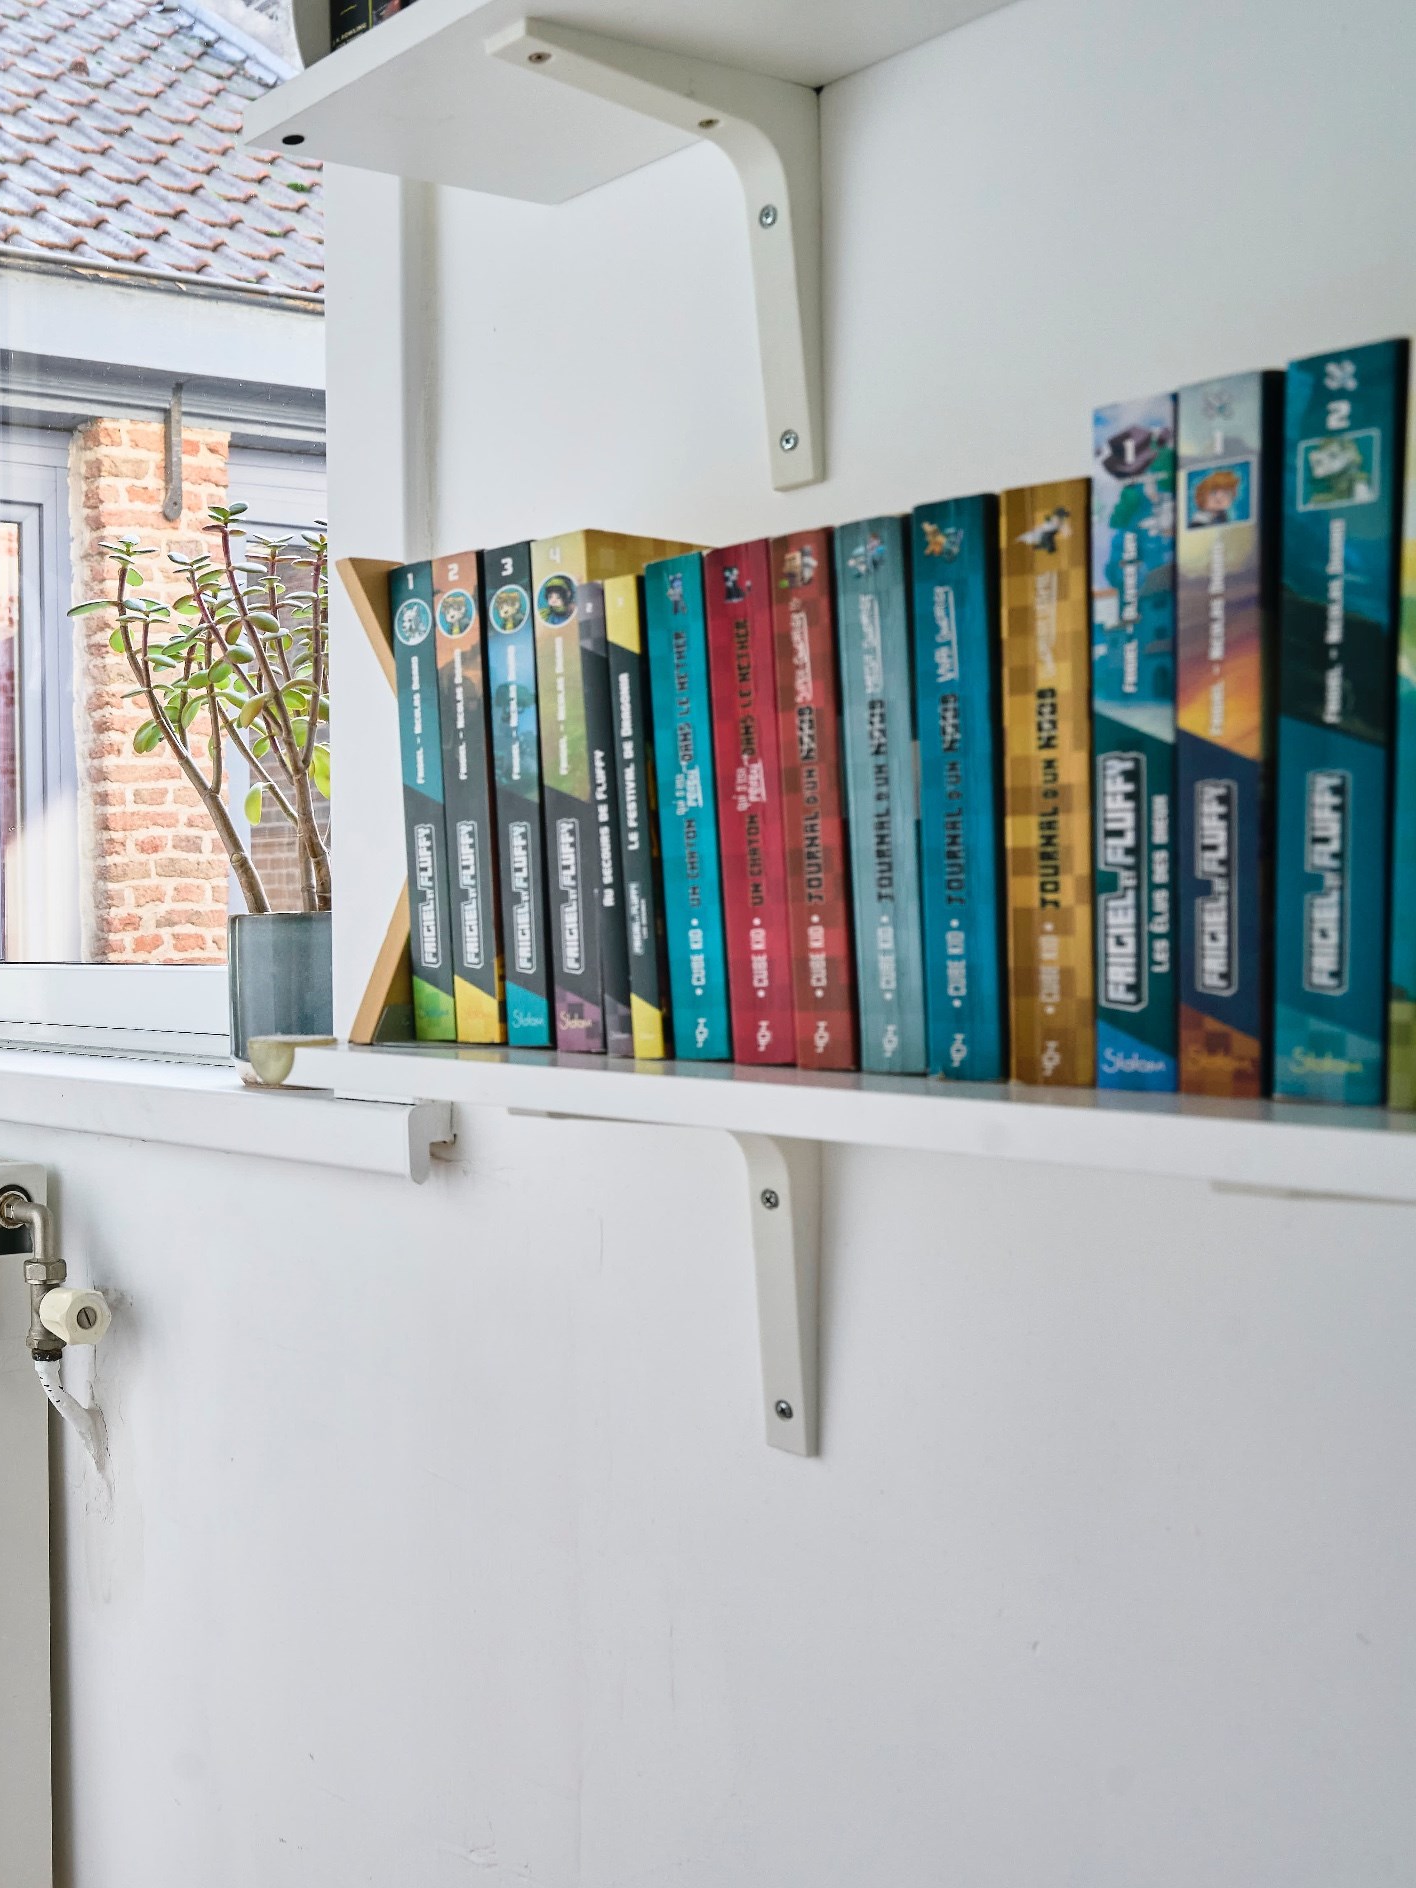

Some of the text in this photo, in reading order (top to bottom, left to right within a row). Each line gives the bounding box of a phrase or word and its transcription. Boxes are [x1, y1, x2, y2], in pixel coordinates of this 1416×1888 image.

[1326, 400, 1351, 430] 2
[1123, 440, 1135, 464] 1
[407, 573, 414, 589] 1
[448, 564, 459, 580] 2
[501, 558, 514, 576] 3
[549, 547, 560, 563] 4
[673, 631, 693, 762] DANS LE NETHER
[735, 618, 756, 755] DANS LE NETHER
[618, 673, 639, 850] LE FESTIVAL DE DRAGONIA
[593, 750, 615, 906] AU SECOURS DE FLUFFY
[1104, 756, 1136, 866] FLUFFY
[1200, 785, 1228, 877] FLUFFY
[1311, 774, 1341, 869] FLUFFY
[416, 825, 433, 887] FLUFFY
[458, 823, 476, 885] FLUFFY
[511, 824, 529, 888] FLUFFY
[559, 822, 577, 886] FLUFFY
[803, 811, 824, 903] JOURNAL
[873, 807, 895, 903] JOURNAL
[944, 807, 966, 906] JOURNAL
[1039, 806, 1060, 910] JOURNAL
[1147, 795, 1170, 972] LES ÉLUS DES DIEUX
[464, 899, 480, 963] FRIGIEL
[684, 819, 706, 985] CUBE KID UN CHATON
[746, 814, 769, 987] CUBE KID UN CHATON
[422, 903, 437, 963] FRIGIEL
[516, 903, 532, 968] FRIGIEL
[564, 904, 580, 969] FRIGIEL
[808, 925, 824, 948] KID
[877, 927, 894, 949] KID
[946, 931, 965, 955] KID
[1038, 935, 1059, 960] KID
[1105, 888, 1136, 1002] FRIGIEL
[1200, 895, 1229, 988] FRIGIEL
[1311, 891, 1341, 987] FRIGIEL
[809, 952, 827, 987] CUBE
[878, 953, 897, 990] CUBE
[946, 960, 967, 996] CUBE
[1039, 966, 1061, 1002] CUBE
